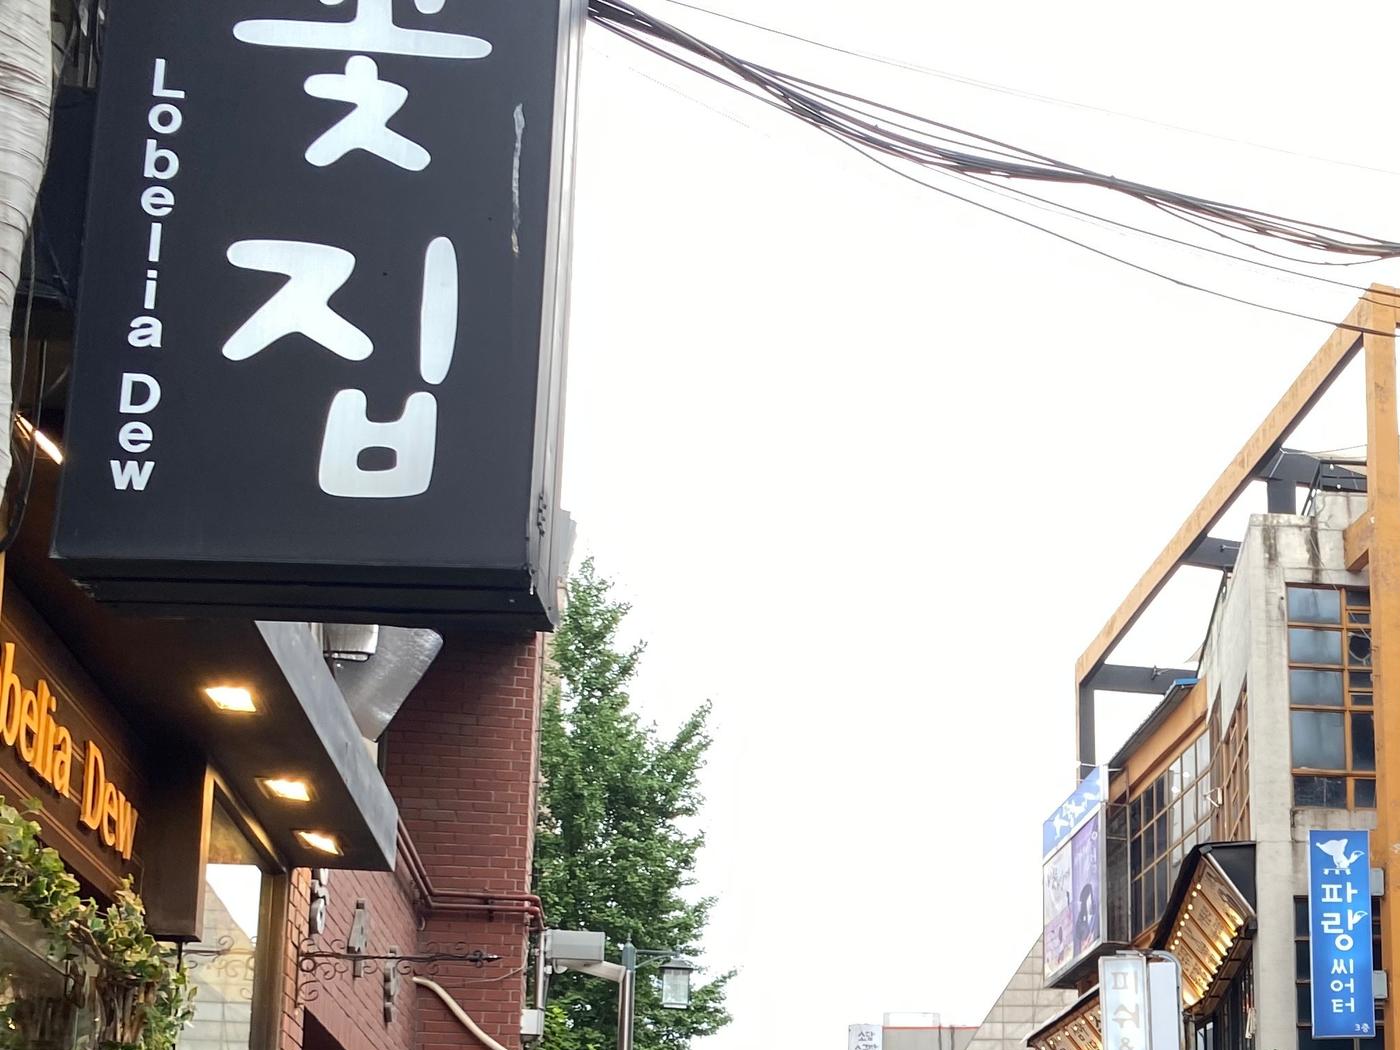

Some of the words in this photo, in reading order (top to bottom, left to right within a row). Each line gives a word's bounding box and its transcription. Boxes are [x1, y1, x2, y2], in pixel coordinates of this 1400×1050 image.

[126, 58, 185, 348] Lobelia
[110, 372, 162, 491] Dew
[0, 642, 72, 799] belia
[80, 739, 139, 861] Dew
[1320, 881, 1368, 952] 파랑
[1330, 958, 1356, 1013] 씨어터
